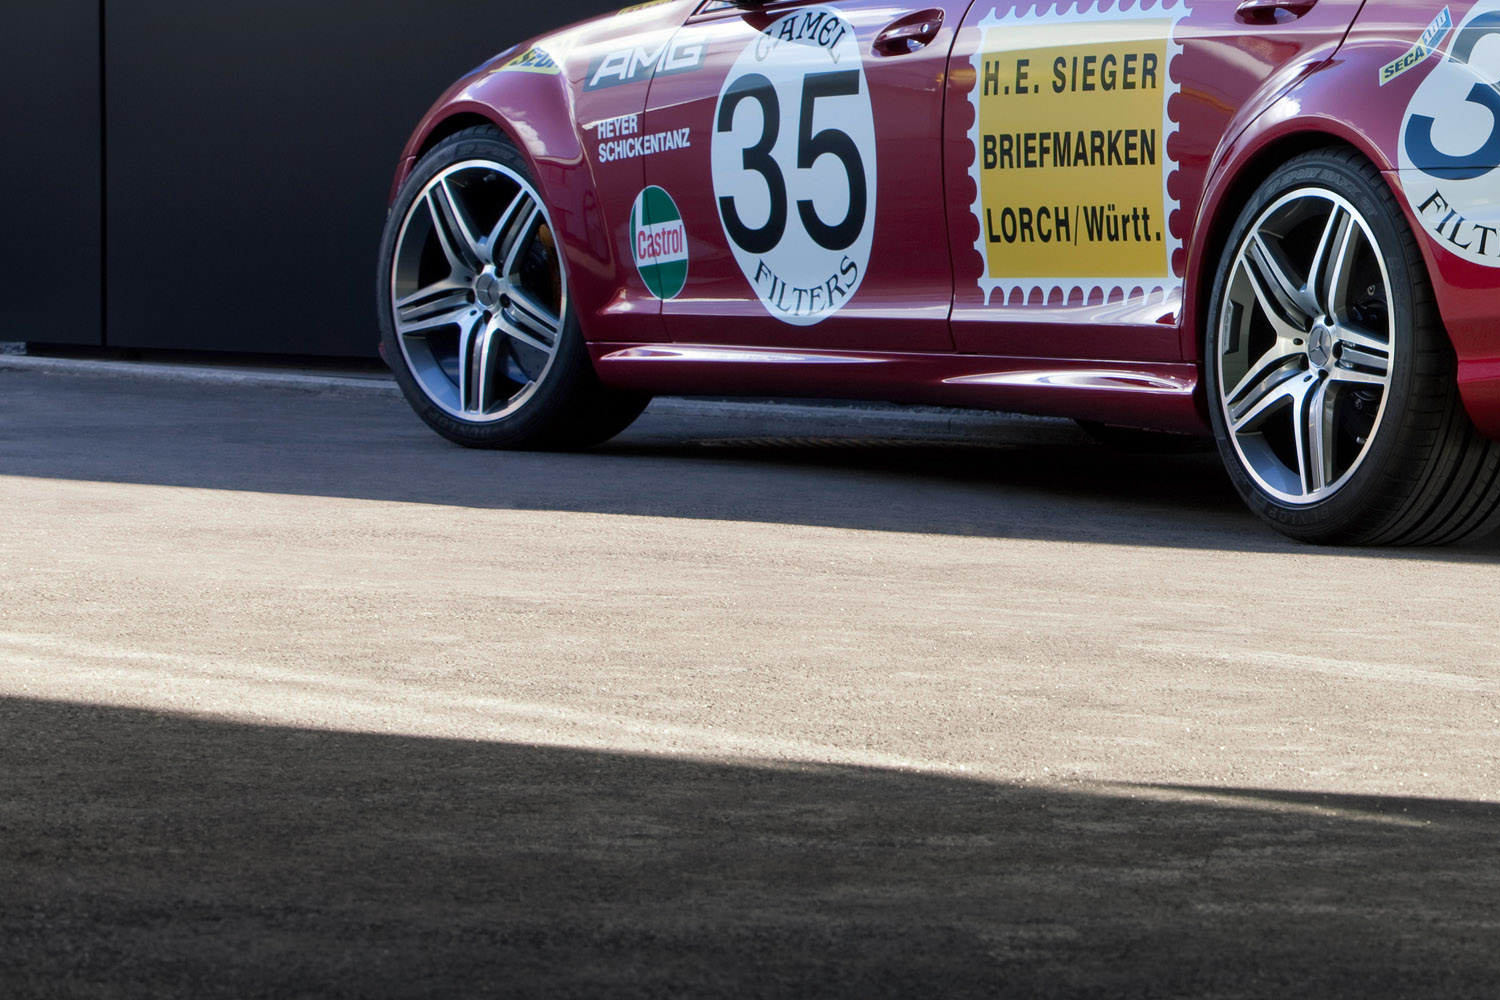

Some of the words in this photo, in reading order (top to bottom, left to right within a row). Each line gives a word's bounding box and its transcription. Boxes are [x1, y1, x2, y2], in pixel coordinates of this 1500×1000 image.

[755, 11, 846, 64] CAMEL
[589, 44, 704, 87] AMG
[983, 58, 1040, 96] H.E.
[1051, 53, 1158, 94] SIEGER
[1384, 44, 1426, 79] SECA
[597, 114, 638, 140] HEYER
[598, 128, 691, 163] SCHICKENTANZ
[716, 68, 868, 255] 35
[983, 128, 1156, 170] BRIEFMARKEN
[637, 224, 683, 260] Castrol
[986, 204, 1162, 247] LORCH/Württ.
[753, 254, 859, 317] FILTERS
